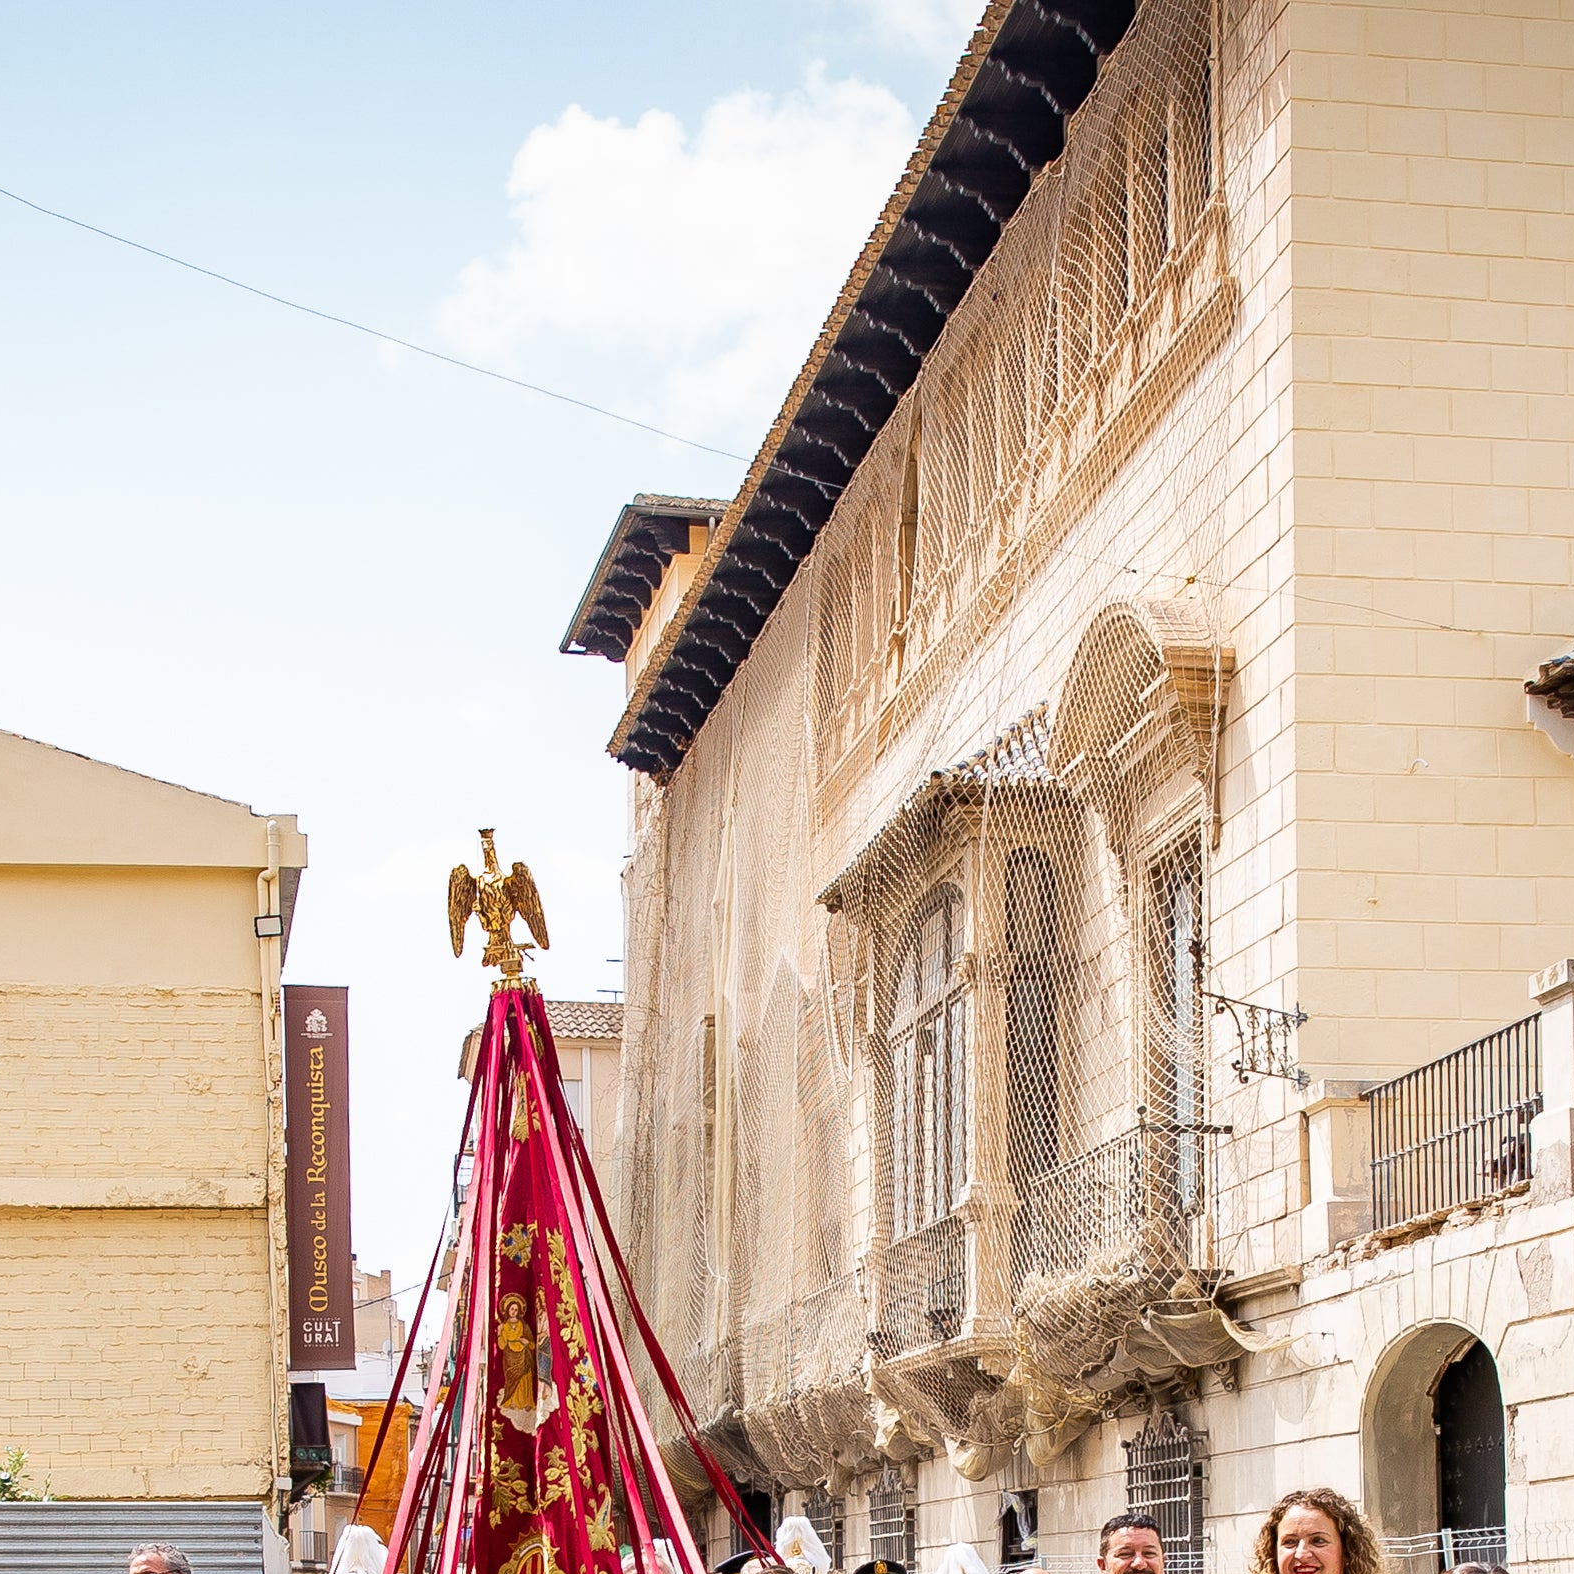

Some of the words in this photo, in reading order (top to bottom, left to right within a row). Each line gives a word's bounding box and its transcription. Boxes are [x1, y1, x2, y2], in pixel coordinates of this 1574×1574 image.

[306, 1045, 331, 1184] Reconquista
[311, 1191, 327, 1207] la
[311, 1212, 327, 1231] de
[309, 1235, 329, 1312] Museo
